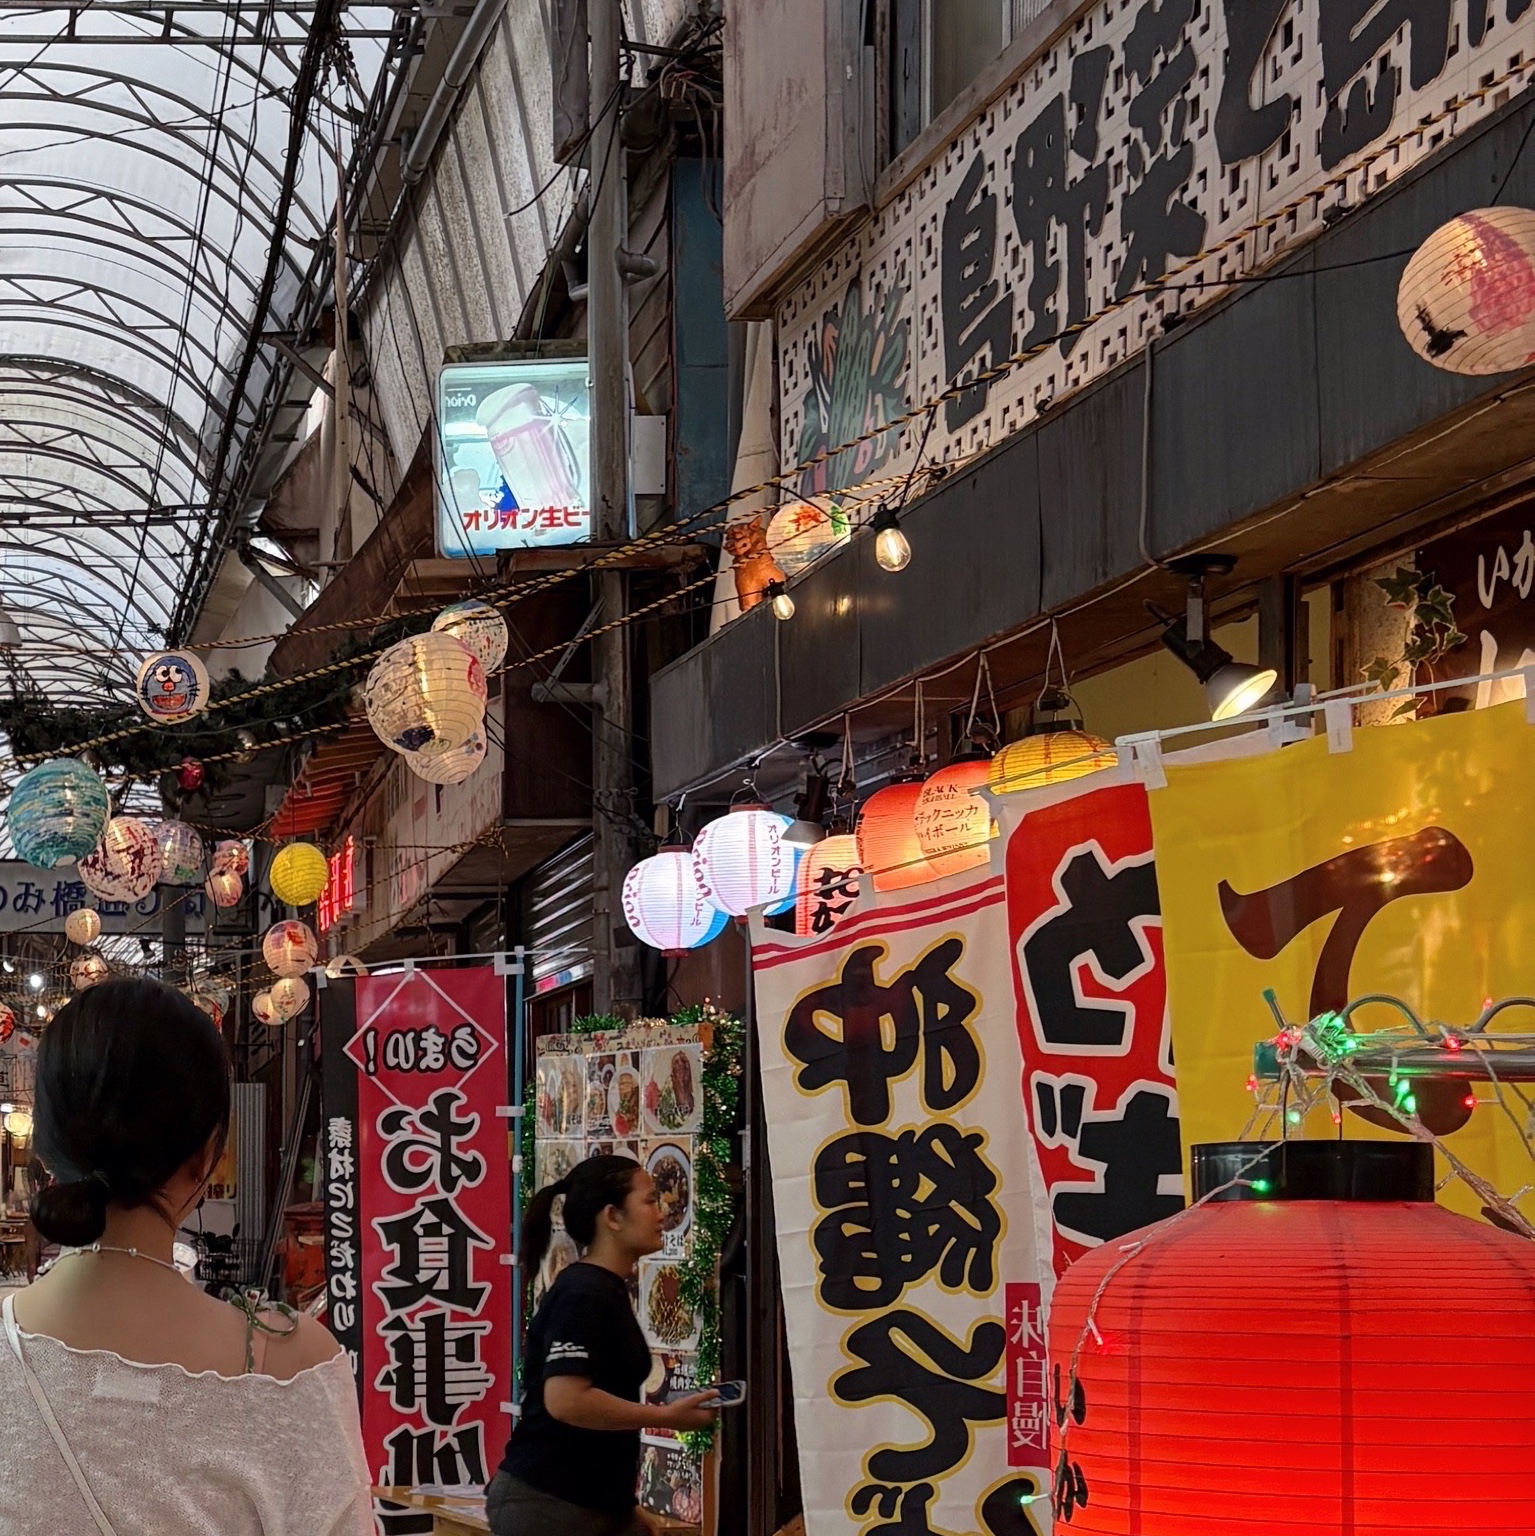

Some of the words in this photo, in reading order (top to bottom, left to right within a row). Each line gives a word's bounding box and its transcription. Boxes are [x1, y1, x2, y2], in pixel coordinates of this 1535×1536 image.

[464, 505, 591, 532] オリオン生ビ
[768, 824, 782, 895] オリオンビール
